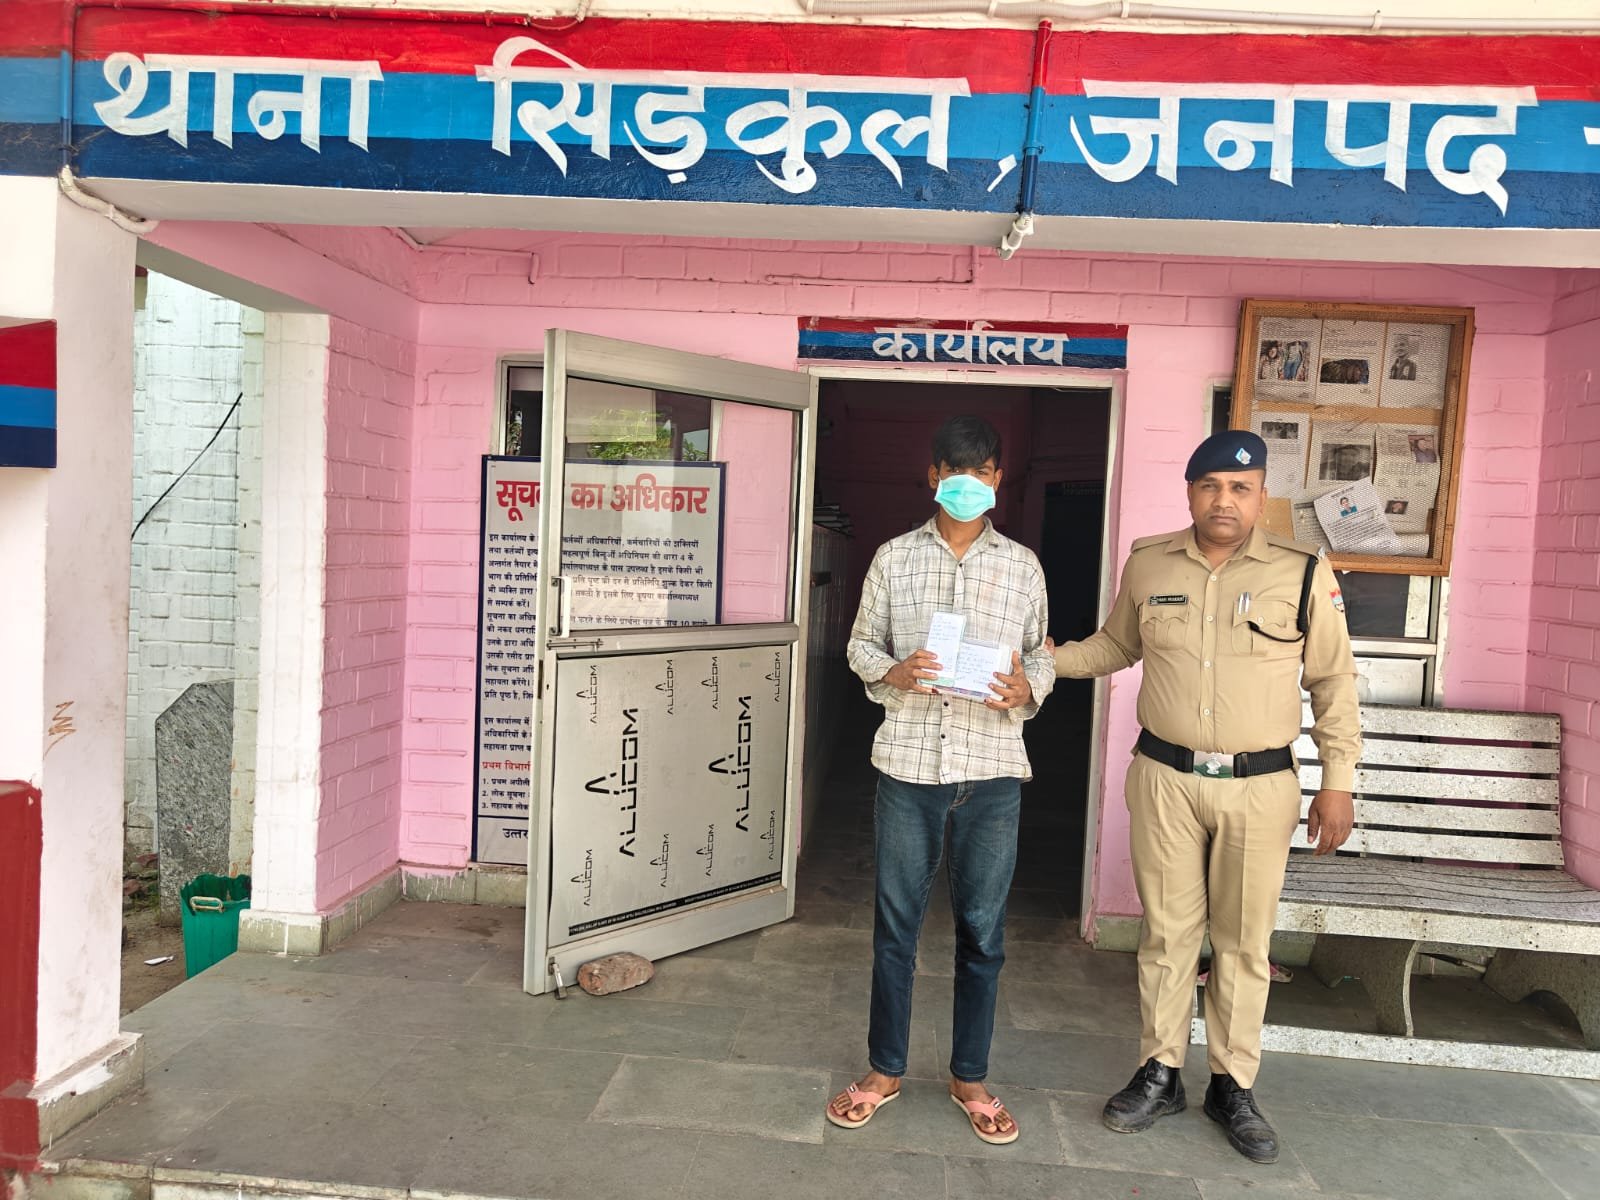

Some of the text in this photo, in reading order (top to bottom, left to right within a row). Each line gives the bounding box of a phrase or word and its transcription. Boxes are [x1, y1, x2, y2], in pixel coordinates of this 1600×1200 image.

[92, 51, 384, 153] थाना
[1070, 79, 1539, 217] जनपद
[872, 320, 1069, 366] कार्यालय
[496, 473, 711, 522] सूच का अधिकार
[619, 708, 638, 857] ALUCOM
[735, 695, 752, 832] ALUCOM
